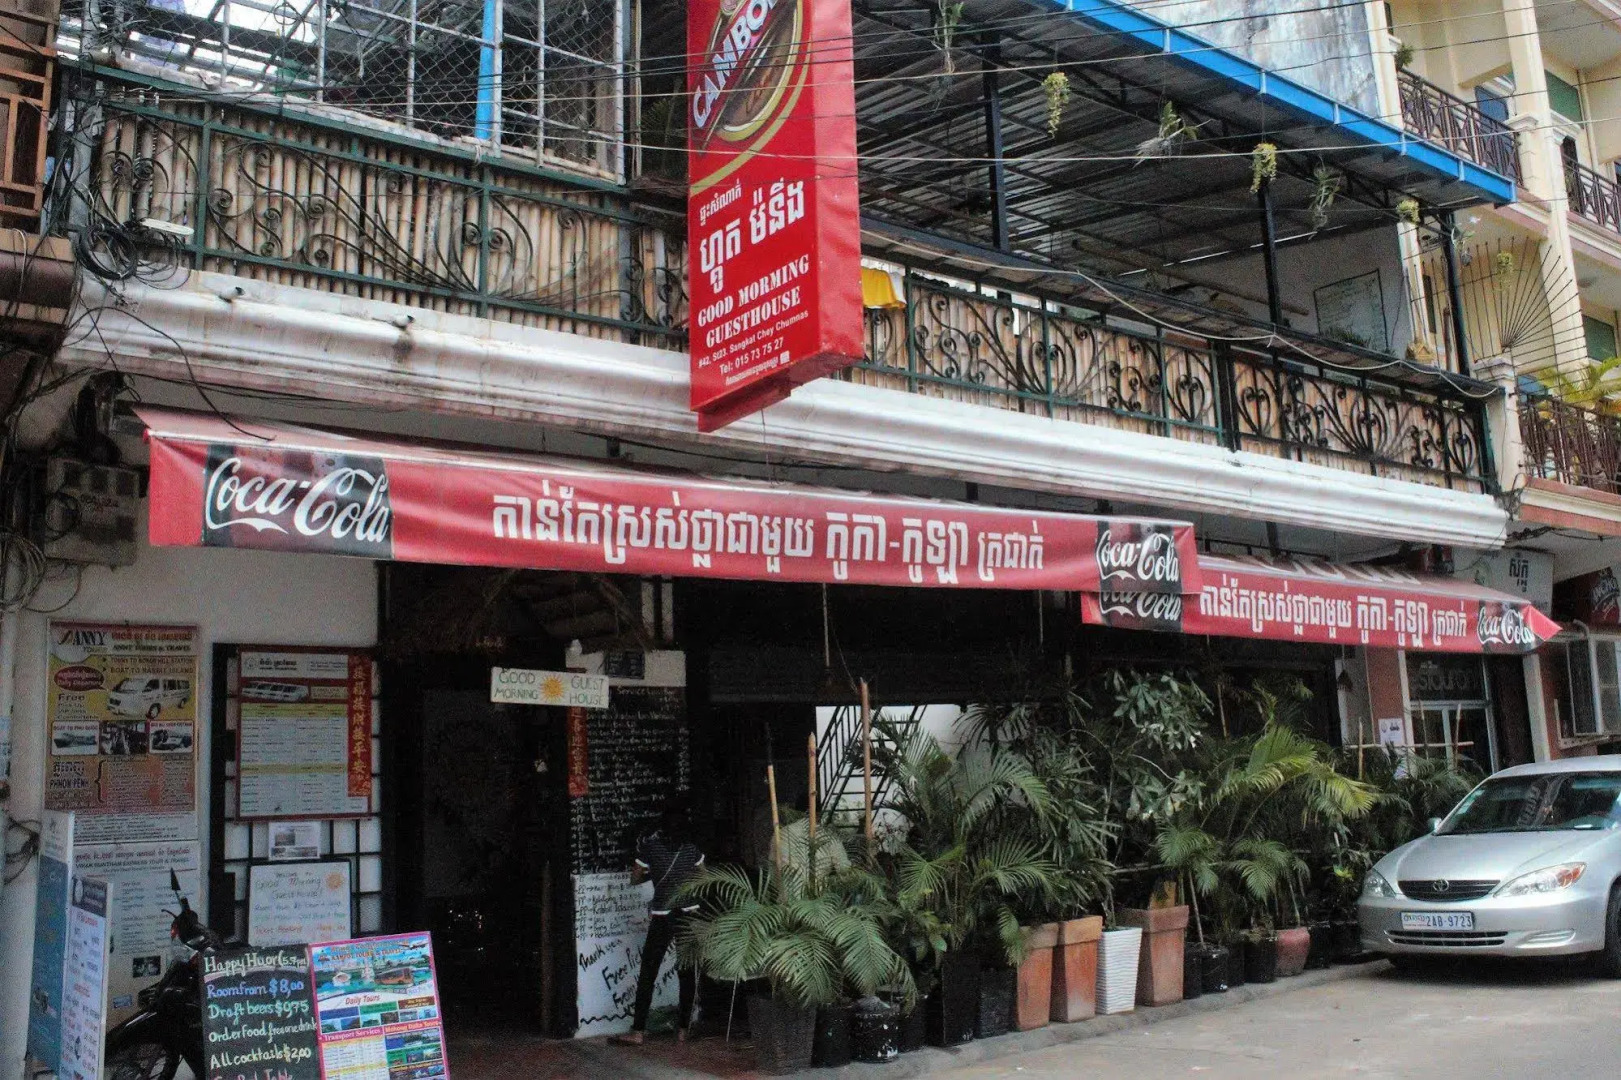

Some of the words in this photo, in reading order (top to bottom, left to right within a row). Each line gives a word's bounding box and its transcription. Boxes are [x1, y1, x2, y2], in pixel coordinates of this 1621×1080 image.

[693, 0, 776, 128] CAMBO
[697, 295, 734, 327] GOOD
[705, 286, 801, 348] GUESTHOUSE
[729, 334, 756, 353] Sangkat
[757, 325, 774, 342] Chey
[720, 360, 733, 375] Tel:
[735, 352, 749, 368] 015
[751, 347, 761, 361] 73
[763, 342, 772, 356] 75
[774, 337, 784, 351] 27
[204, 457, 393, 543] Coca-Cola
[1096, 529, 1179, 582] Coca-Cola
[1477, 605, 1535, 645] Coca-Cola
[499, 671, 535, 685] GOOD
[58, 693, 85, 701] Free
[494, 687, 539, 700] MORNING
[570, 692, 604, 705] HOUSE
[204, 956, 245, 977] Happy
[207, 984, 239, 999] Room
[239, 981, 268, 996] from
[345, 996, 361, 1005] Daily
[363, 994, 381, 1002] Tours
[208, 1003, 245, 1025] Draft
[209, 1026, 241, 1042] Order
[324, 1031, 354, 1042] Transport
[210, 1052, 232, 1069] All
[233, 1043, 284, 1065] cocktails
